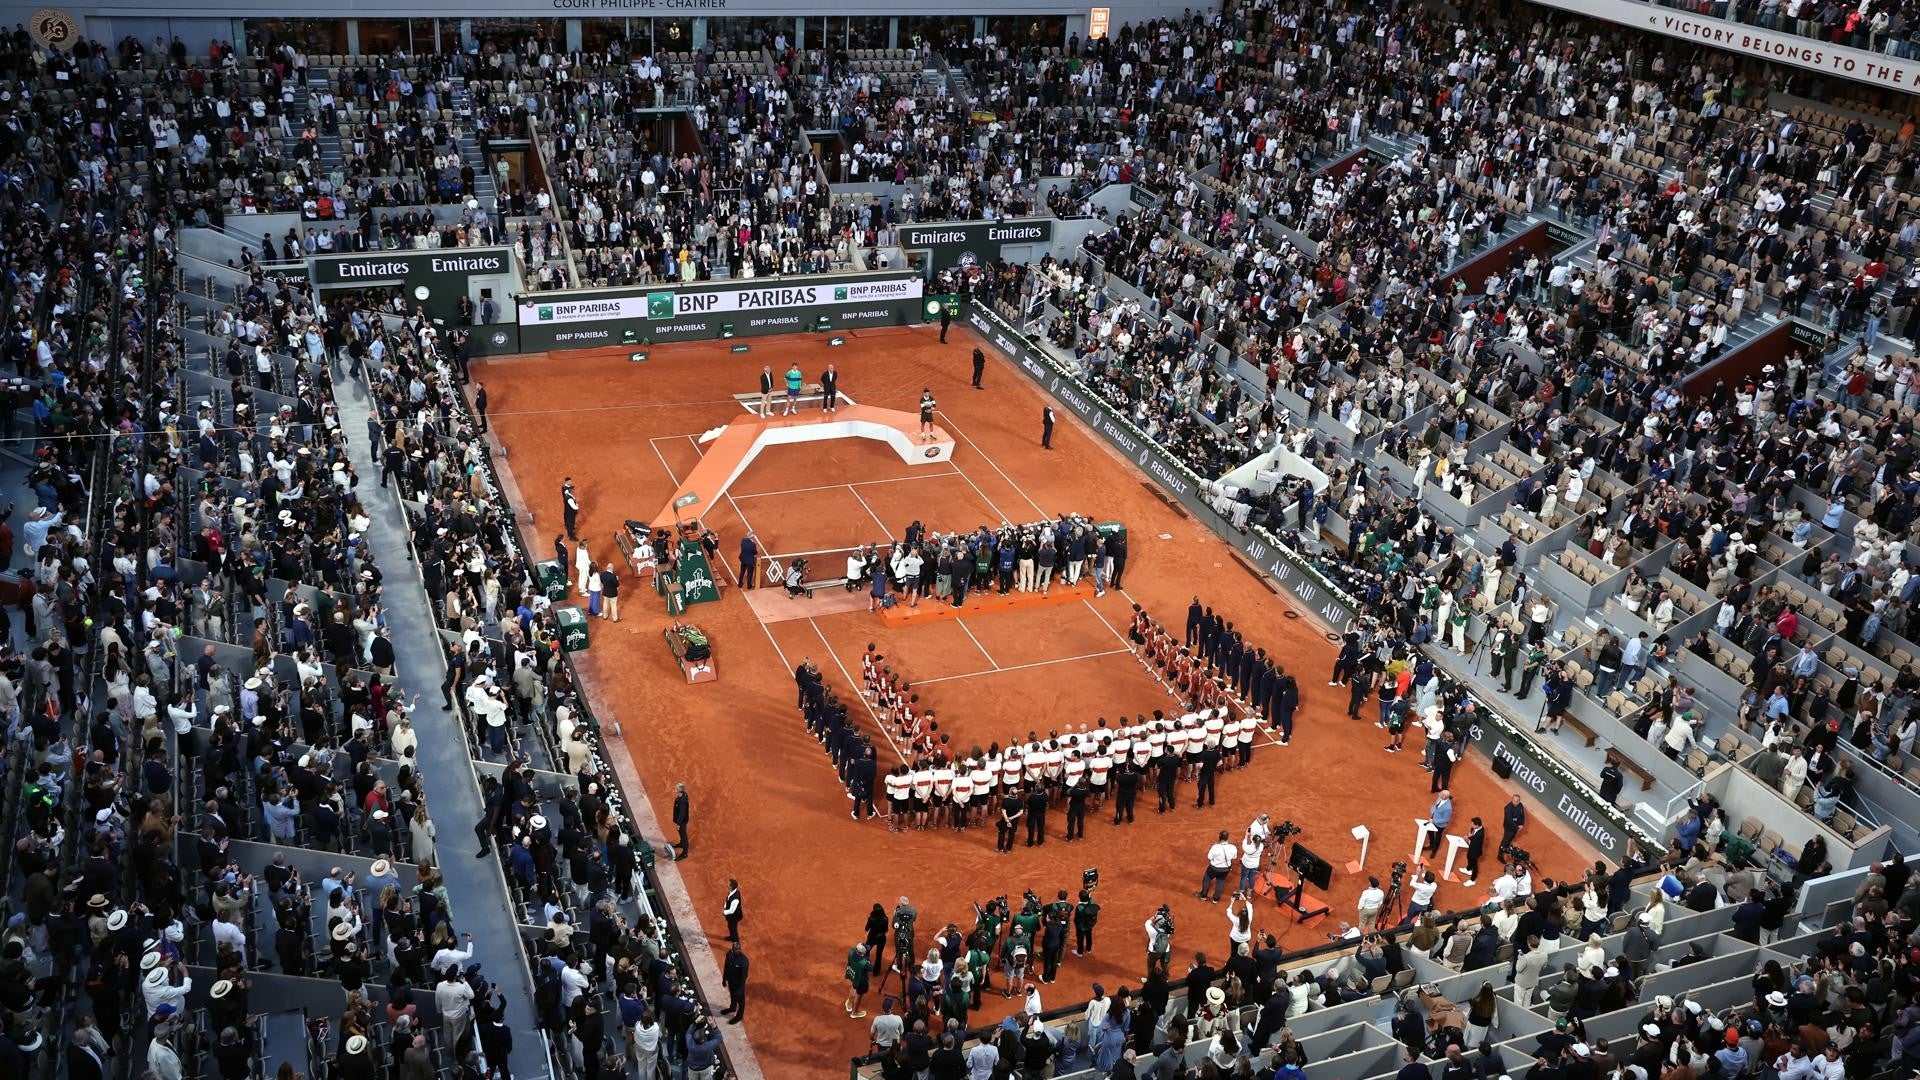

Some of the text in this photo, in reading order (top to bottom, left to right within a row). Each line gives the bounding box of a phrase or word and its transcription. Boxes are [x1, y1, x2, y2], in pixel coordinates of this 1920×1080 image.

[1665, 16, 1734, 43] VICTORY
[1742, 36, 1822, 64] BELONGS
[1834, 56, 1856, 71] TO
[1867, 63, 1904, 82] THE
[911, 231, 966, 245] Emirates
[988, 227, 1042, 241] Emirates
[339, 261, 409, 277] Emirates
[432, 256, 499, 273] Emirates
[850, 284, 906, 294] BNP PARIBAS
[556, 303, 620, 314] BNP PARIBAS
[679, 288, 816, 312] BNP PARIBAS
[556, 330, 608, 341] BNP PARIBAS
[674, 324, 706, 332] PARIBAS
[1061, 387, 1092, 415] RENAULT
[1103, 422, 1137, 452] RENAULT
[1150, 460, 1188, 494] RENAULT
[685, 577, 712, 597] Perrier
[1493, 741, 1547, 793] Emirates
[1557, 793, 1617, 851] Emirates
